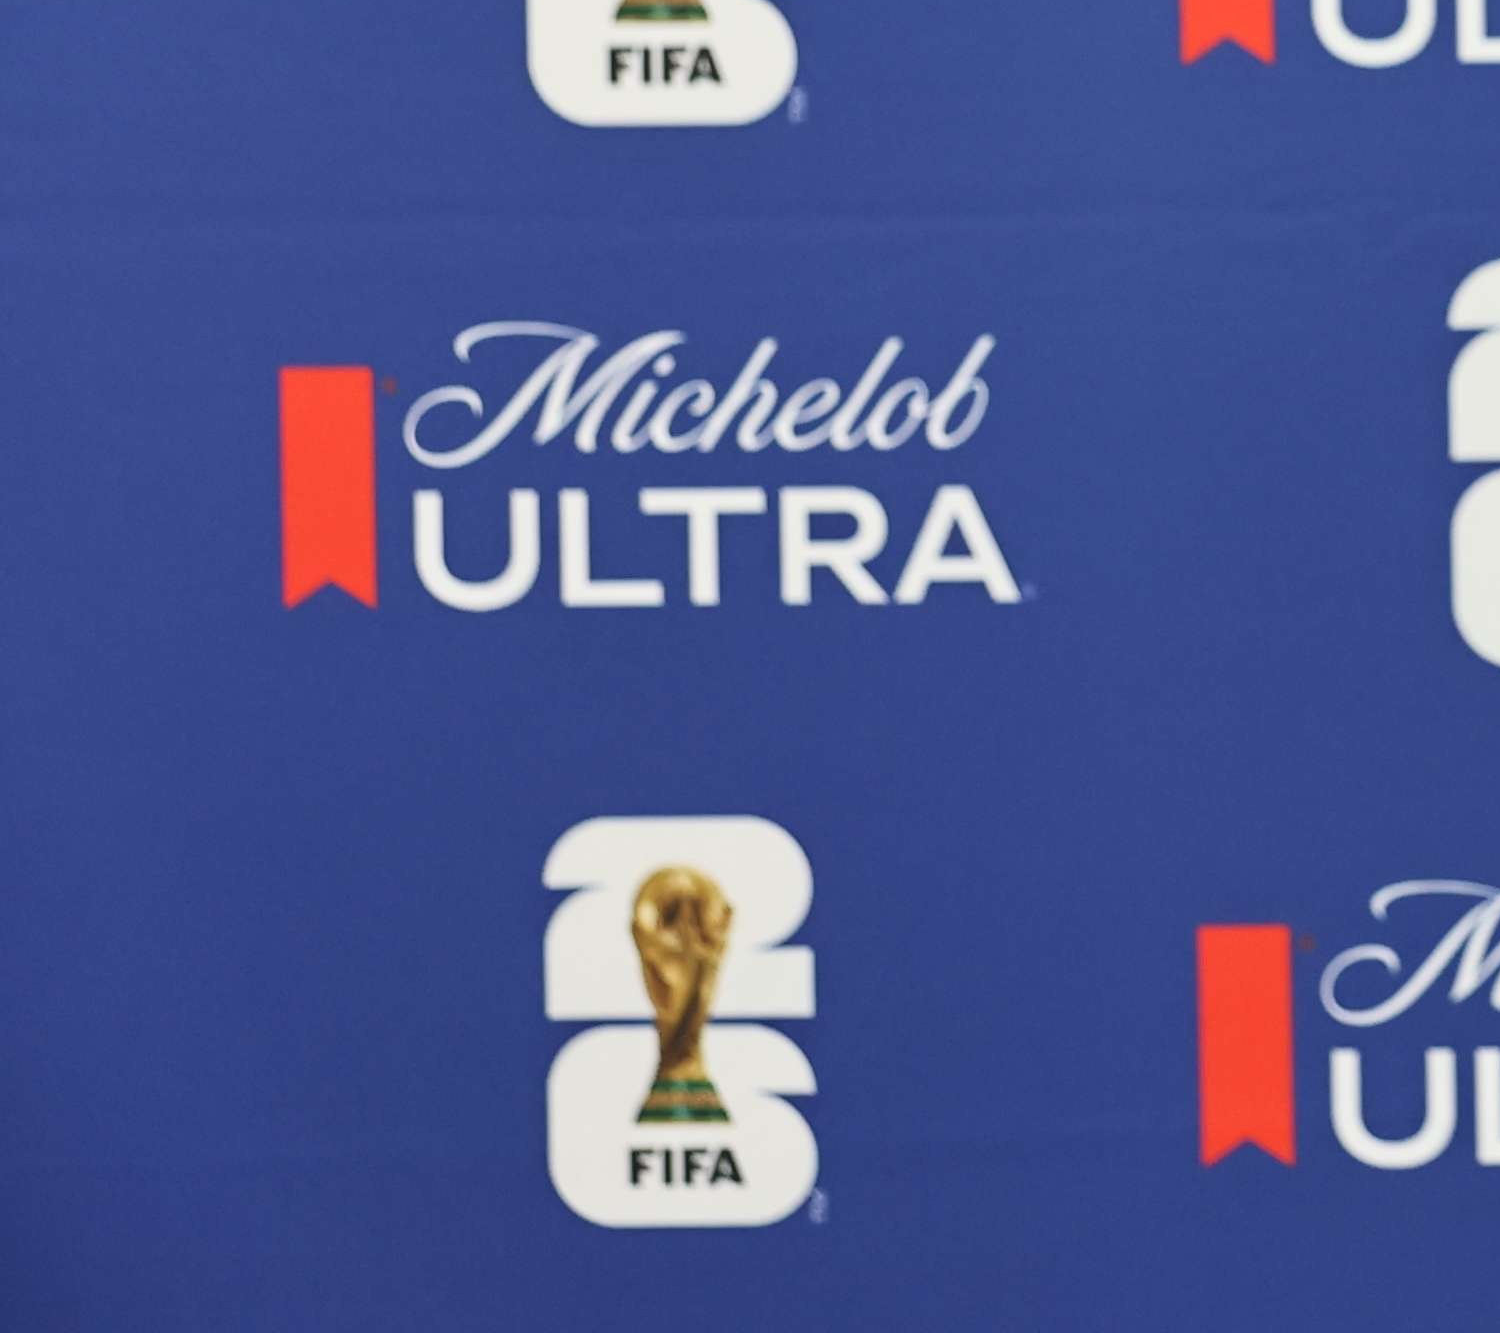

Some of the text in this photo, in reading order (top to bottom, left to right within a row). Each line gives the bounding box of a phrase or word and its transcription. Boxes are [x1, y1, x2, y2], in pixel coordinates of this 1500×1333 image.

[607, 44, 723, 86] FIFA
[402, 320, 995, 470] Michelob
[412, 484, 1022, 613] ULTRA
[627, 1146, 745, 1188] FIFA
